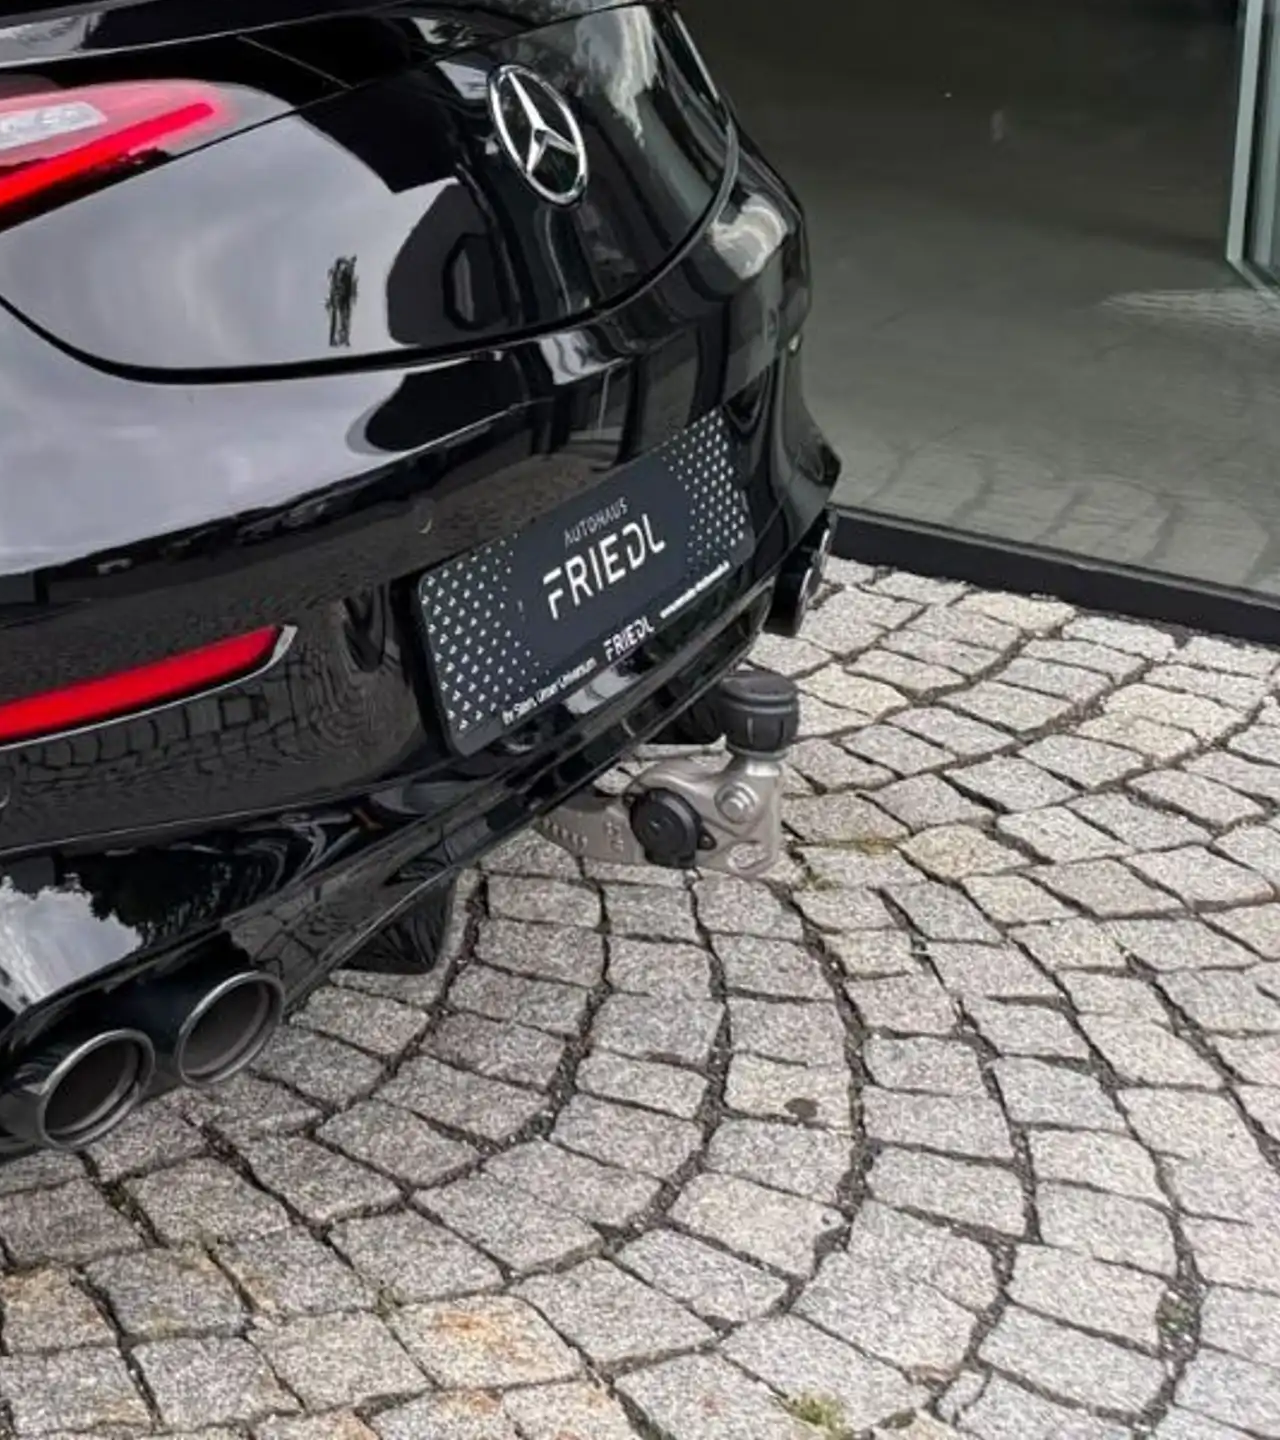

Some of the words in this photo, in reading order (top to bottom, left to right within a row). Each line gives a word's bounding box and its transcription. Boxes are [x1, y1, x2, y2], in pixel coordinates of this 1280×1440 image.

[563, 497, 628, 548] AUTOHAUS
[543, 513, 666, 620] FRIEDL
[603, 616, 655, 662] FRIEDL
